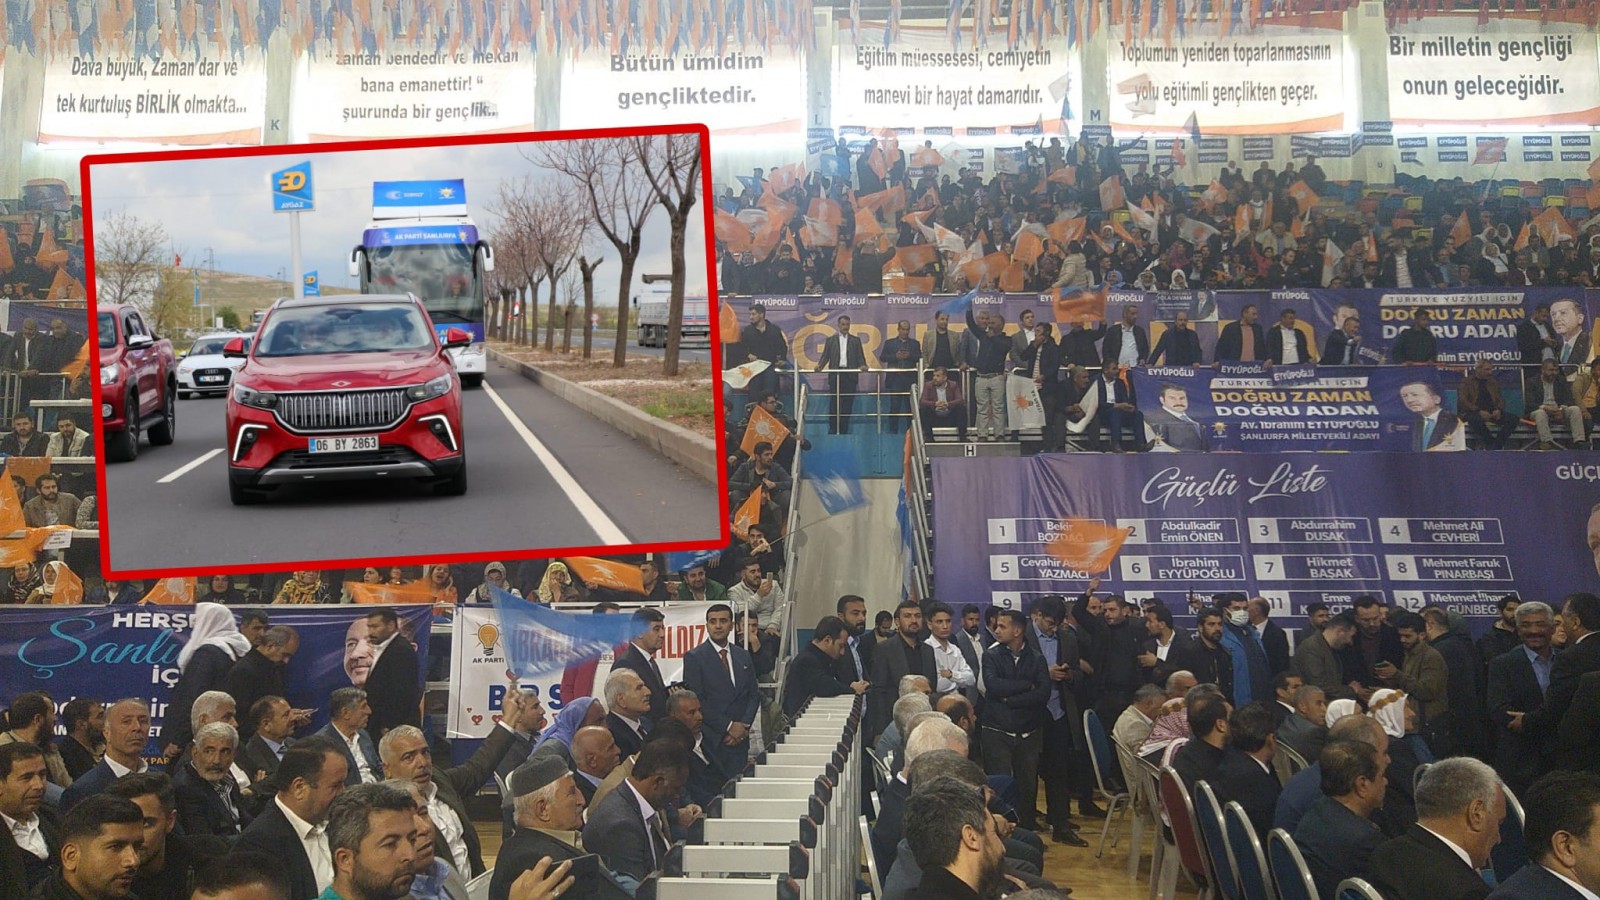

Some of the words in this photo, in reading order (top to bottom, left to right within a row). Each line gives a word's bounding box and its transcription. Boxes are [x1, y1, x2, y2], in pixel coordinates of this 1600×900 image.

[1390, 35, 1415, 56] Bir
[1421, 36, 1492, 56] milletin
[1499, 35, 1573, 62] gençliği
[856, 48, 897, 70] Eğitim
[901, 48, 983, 70] müessesesi,
[987, 46, 1051, 71] cemiyetin
[1182, 42, 1230, 68] yeniden
[1233, 42, 1331, 67] toparlanmasının
[611, 55, 675, 72] Bütün
[683, 52, 763, 71] ümidim
[72, 57, 102, 76] Dava
[106, 57, 147, 81] büyük,
[151, 57, 194, 76] Zaman
[199, 57, 218, 76] dar
[224, 61, 238, 76] ve
[361, 77, 394, 92] bana
[399, 76, 472, 92] emanettir!
[1403, 79, 1448, 95] onun
[1455, 74, 1564, 100] geleceğidir.
[618, 85, 756, 110] gençliktedir.
[864, 85, 911, 105] manevi
[915, 85, 932, 105] bir
[936, 85, 973, 110] hayat
[977, 84, 1043, 106] damarıdır.
[1135, 82, 1159, 106] yolu
[1163, 81, 1209, 106] eğitimli
[1213, 80, 1277, 107] gençlikten
[1281, 85, 1318, 107] geçer.
[57, 93, 76, 113] tek
[79, 94, 131, 118] kurtuluş
[136, 89, 181, 114] BİRLİK
[184, 94, 247, 114] olmakta...
[343, 104, 408, 122] şuurunda
[413, 104, 430, 119] bir
[1090, 110, 1101, 121] M
[271, 120, 280, 131] K
[824, 297, 866, 306] EYYÜPOĞLU
[888, 296, 929, 304] EYYÜPOĞLU
[1106, 293, 1144, 302] YYÜPOĞLU
[1451, 308, 1525, 320] ZAMAN
[1148, 368, 1194, 377] EYYÜPOĞLU
[1211, 389, 1287, 403] DOĞRU
[1291, 390, 1372, 402] ZAMAN
[1215, 404, 1300, 416] DOĞRU
[1306, 405, 1380, 416] ADAM
[1241, 433, 1289, 441] ŞANLIURFA
[1352, 432, 1380, 440] ADAYI
[316, 440, 328, 451] 06
[335, 438, 347, 450] BY
[352, 437, 376, 450] 2863
[966, 445, 975, 456] H
[1141, 466, 1240, 510] Güçlü
[1248, 462, 1334, 504] Liste
[1046, 521, 1074, 531] Bekir
[1161, 521, 1222, 530] Abdulkadir
[1260, 525, 1270, 536] 3
[1290, 520, 1356, 530] Abdurrahim
[1390, 525, 1400, 536] 4
[1423, 521, 1469, 530] Mehmet
[1470, 521, 1484, 530] Ali
[1000, 526, 1006, 536] 1
[1128, 526, 1138, 537] 2
[1161, 533, 1188, 542] Emin
[1189, 531, 1224, 542] ÖNEN
[1304, 532, 1345, 541] DUSAK
[1432, 531, 1480, 542] CEVHERİ
[1000, 562, 1010, 573] 5
[1020, 558, 1060, 568] Cevahir
[1171, 556, 1220, 568] İbrahim
[1264, 562, 1274, 573] 7
[1306, 557, 1354, 567] Hikmet
[1397, 562, 1408, 573] 8
[1423, 558, 1468, 568] Mehmet
[1470, 558, 1501, 568] Faruk
[1132, 562, 1142, 574] 6
[1158, 567, 1236, 578] EYYÜPOĞLU
[1310, 568, 1354, 580] BAŞAK
[1434, 570, 1494, 580] PINARBAŞI
[1321, 593, 1352, 602] Emre
[1430, 593, 1477, 602] Mehmet
[1002, 598, 1012, 610] 9
[1268, 598, 1283, 609] 11
[1402, 598, 1420, 609] 12
[152, 664, 180, 688] İÇ
